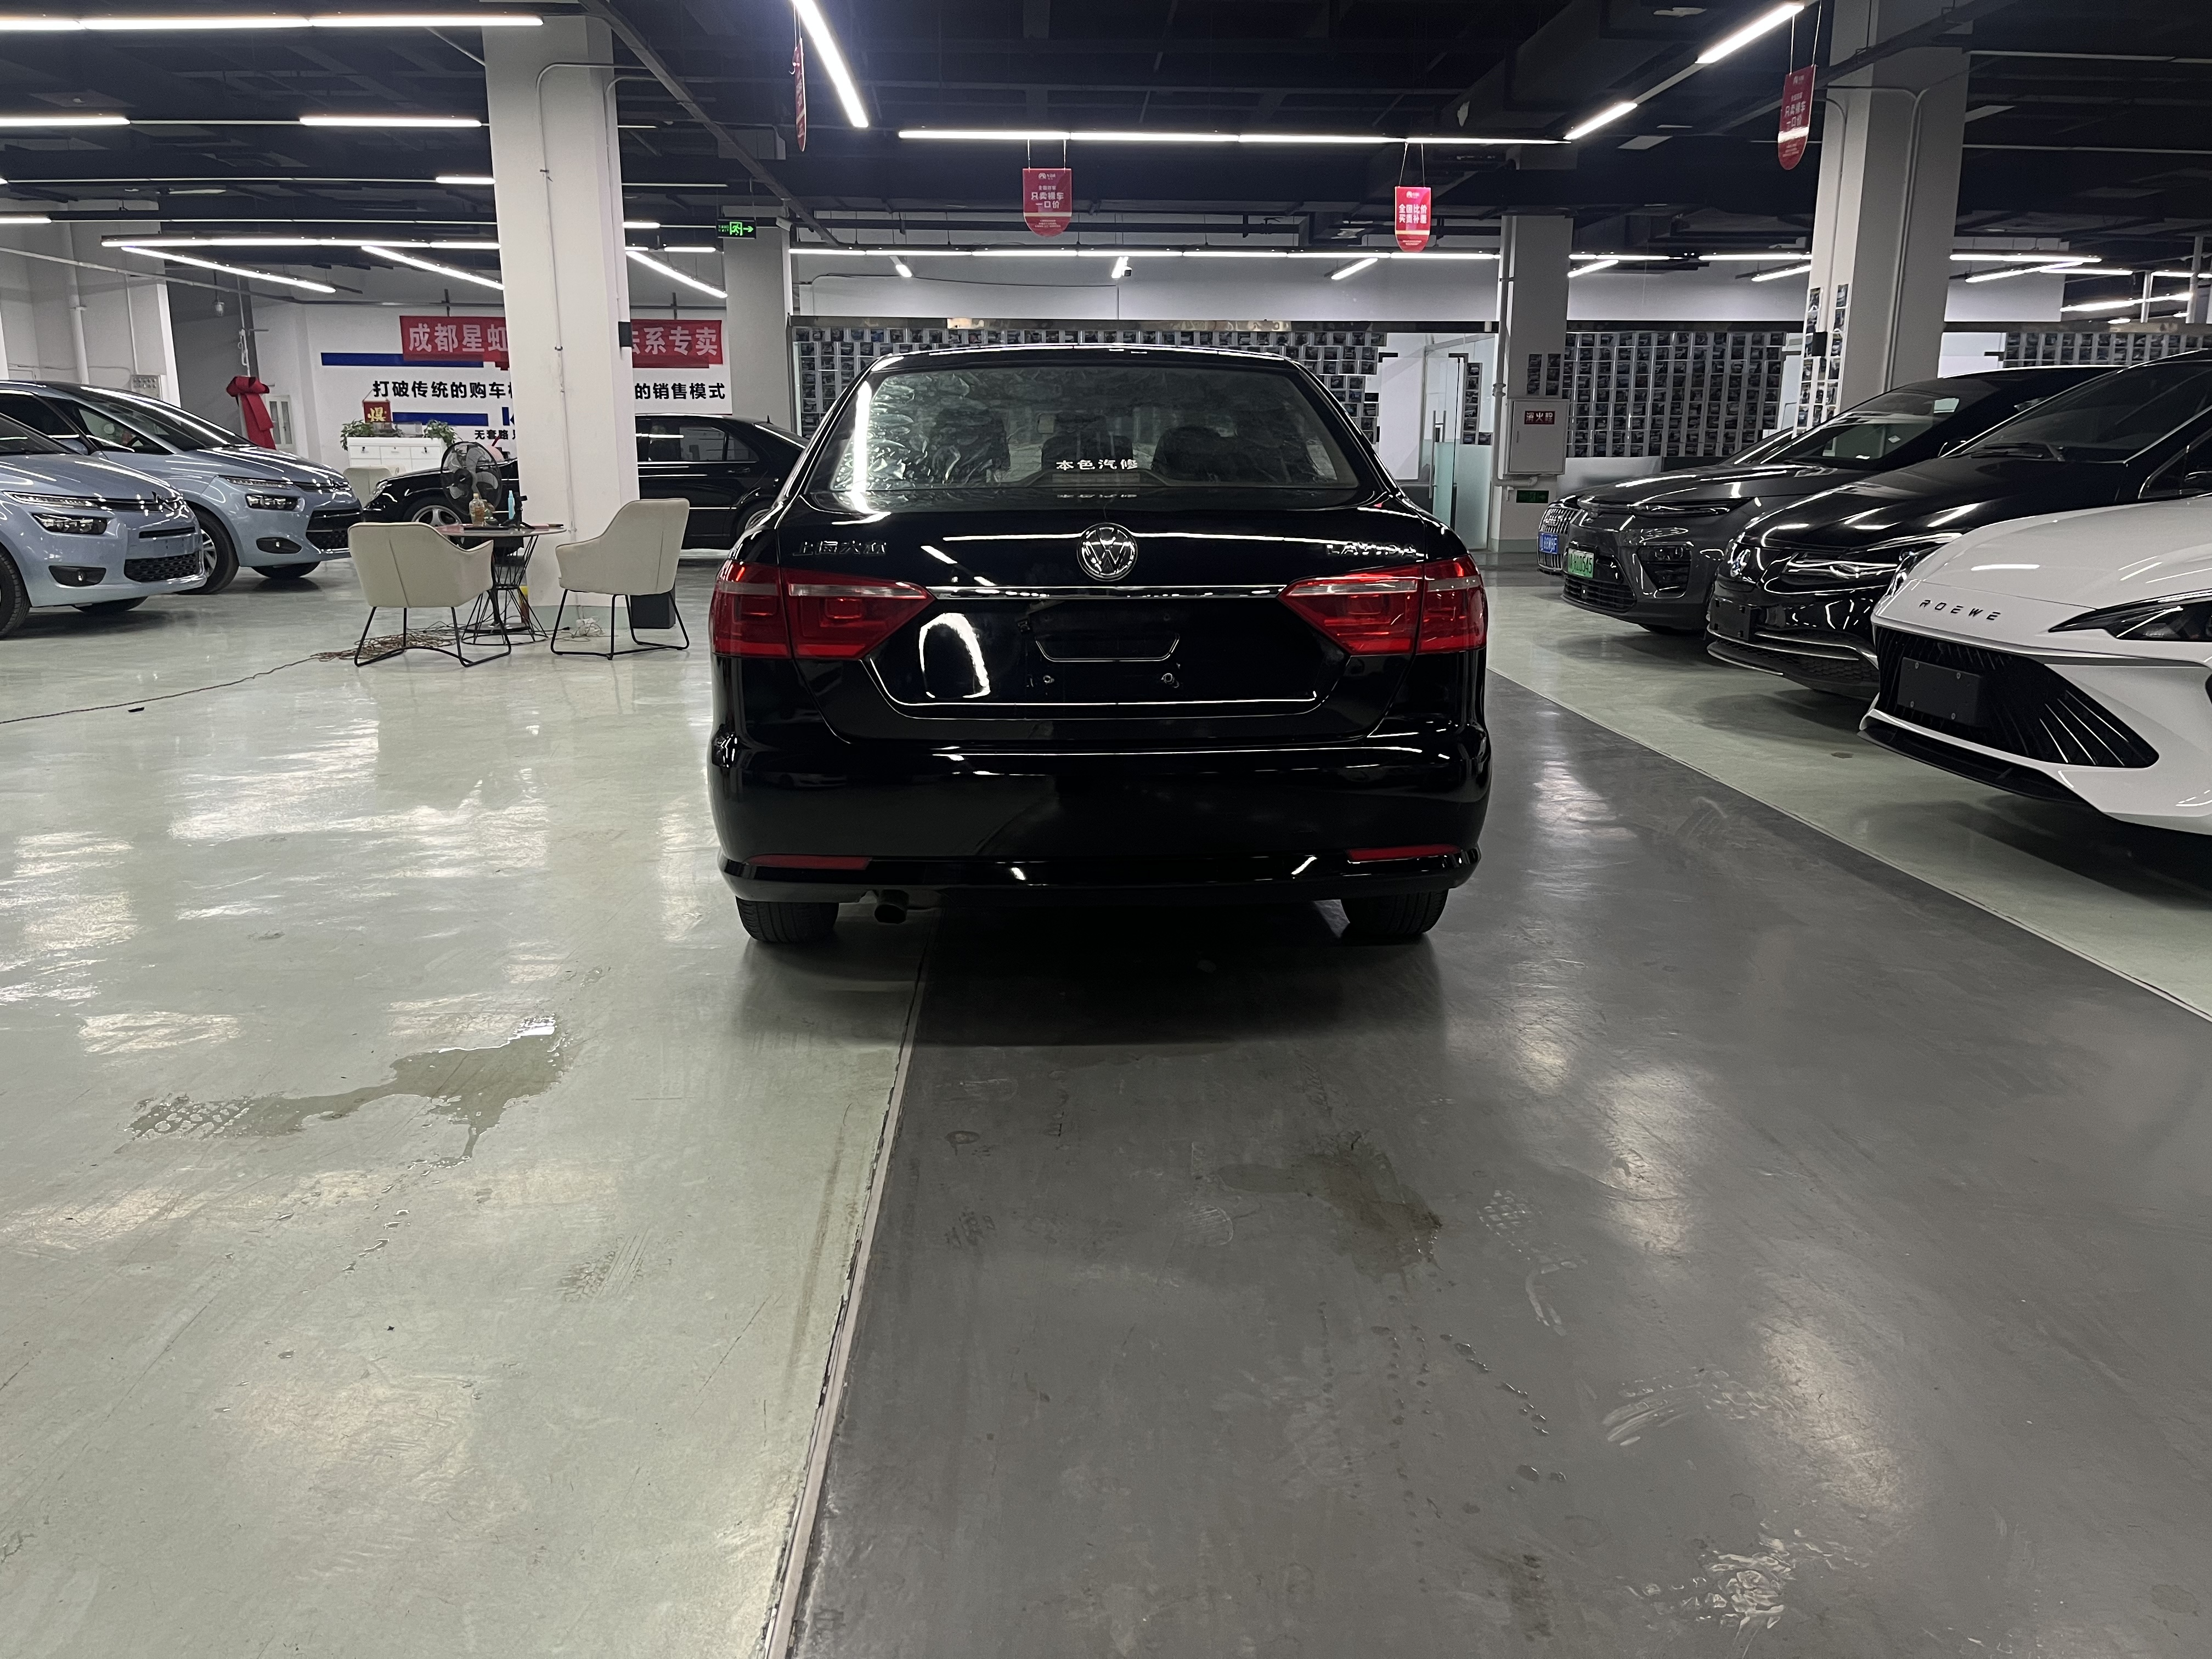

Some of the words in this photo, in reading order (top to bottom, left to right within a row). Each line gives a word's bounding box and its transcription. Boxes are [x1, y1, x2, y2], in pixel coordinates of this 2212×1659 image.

[1398, 204, 1427, 214] 全国比价
[409, 323, 508, 353] 成都星虹
[373, 381, 512, 398] 打破传统的购车
[635, 383, 725, 399] 的销售模式
[475, 430, 515, 439] 无套路
[1056, 459, 1138, 470] 本色汽修
[1919, 600, 2001, 620] ROEWE
